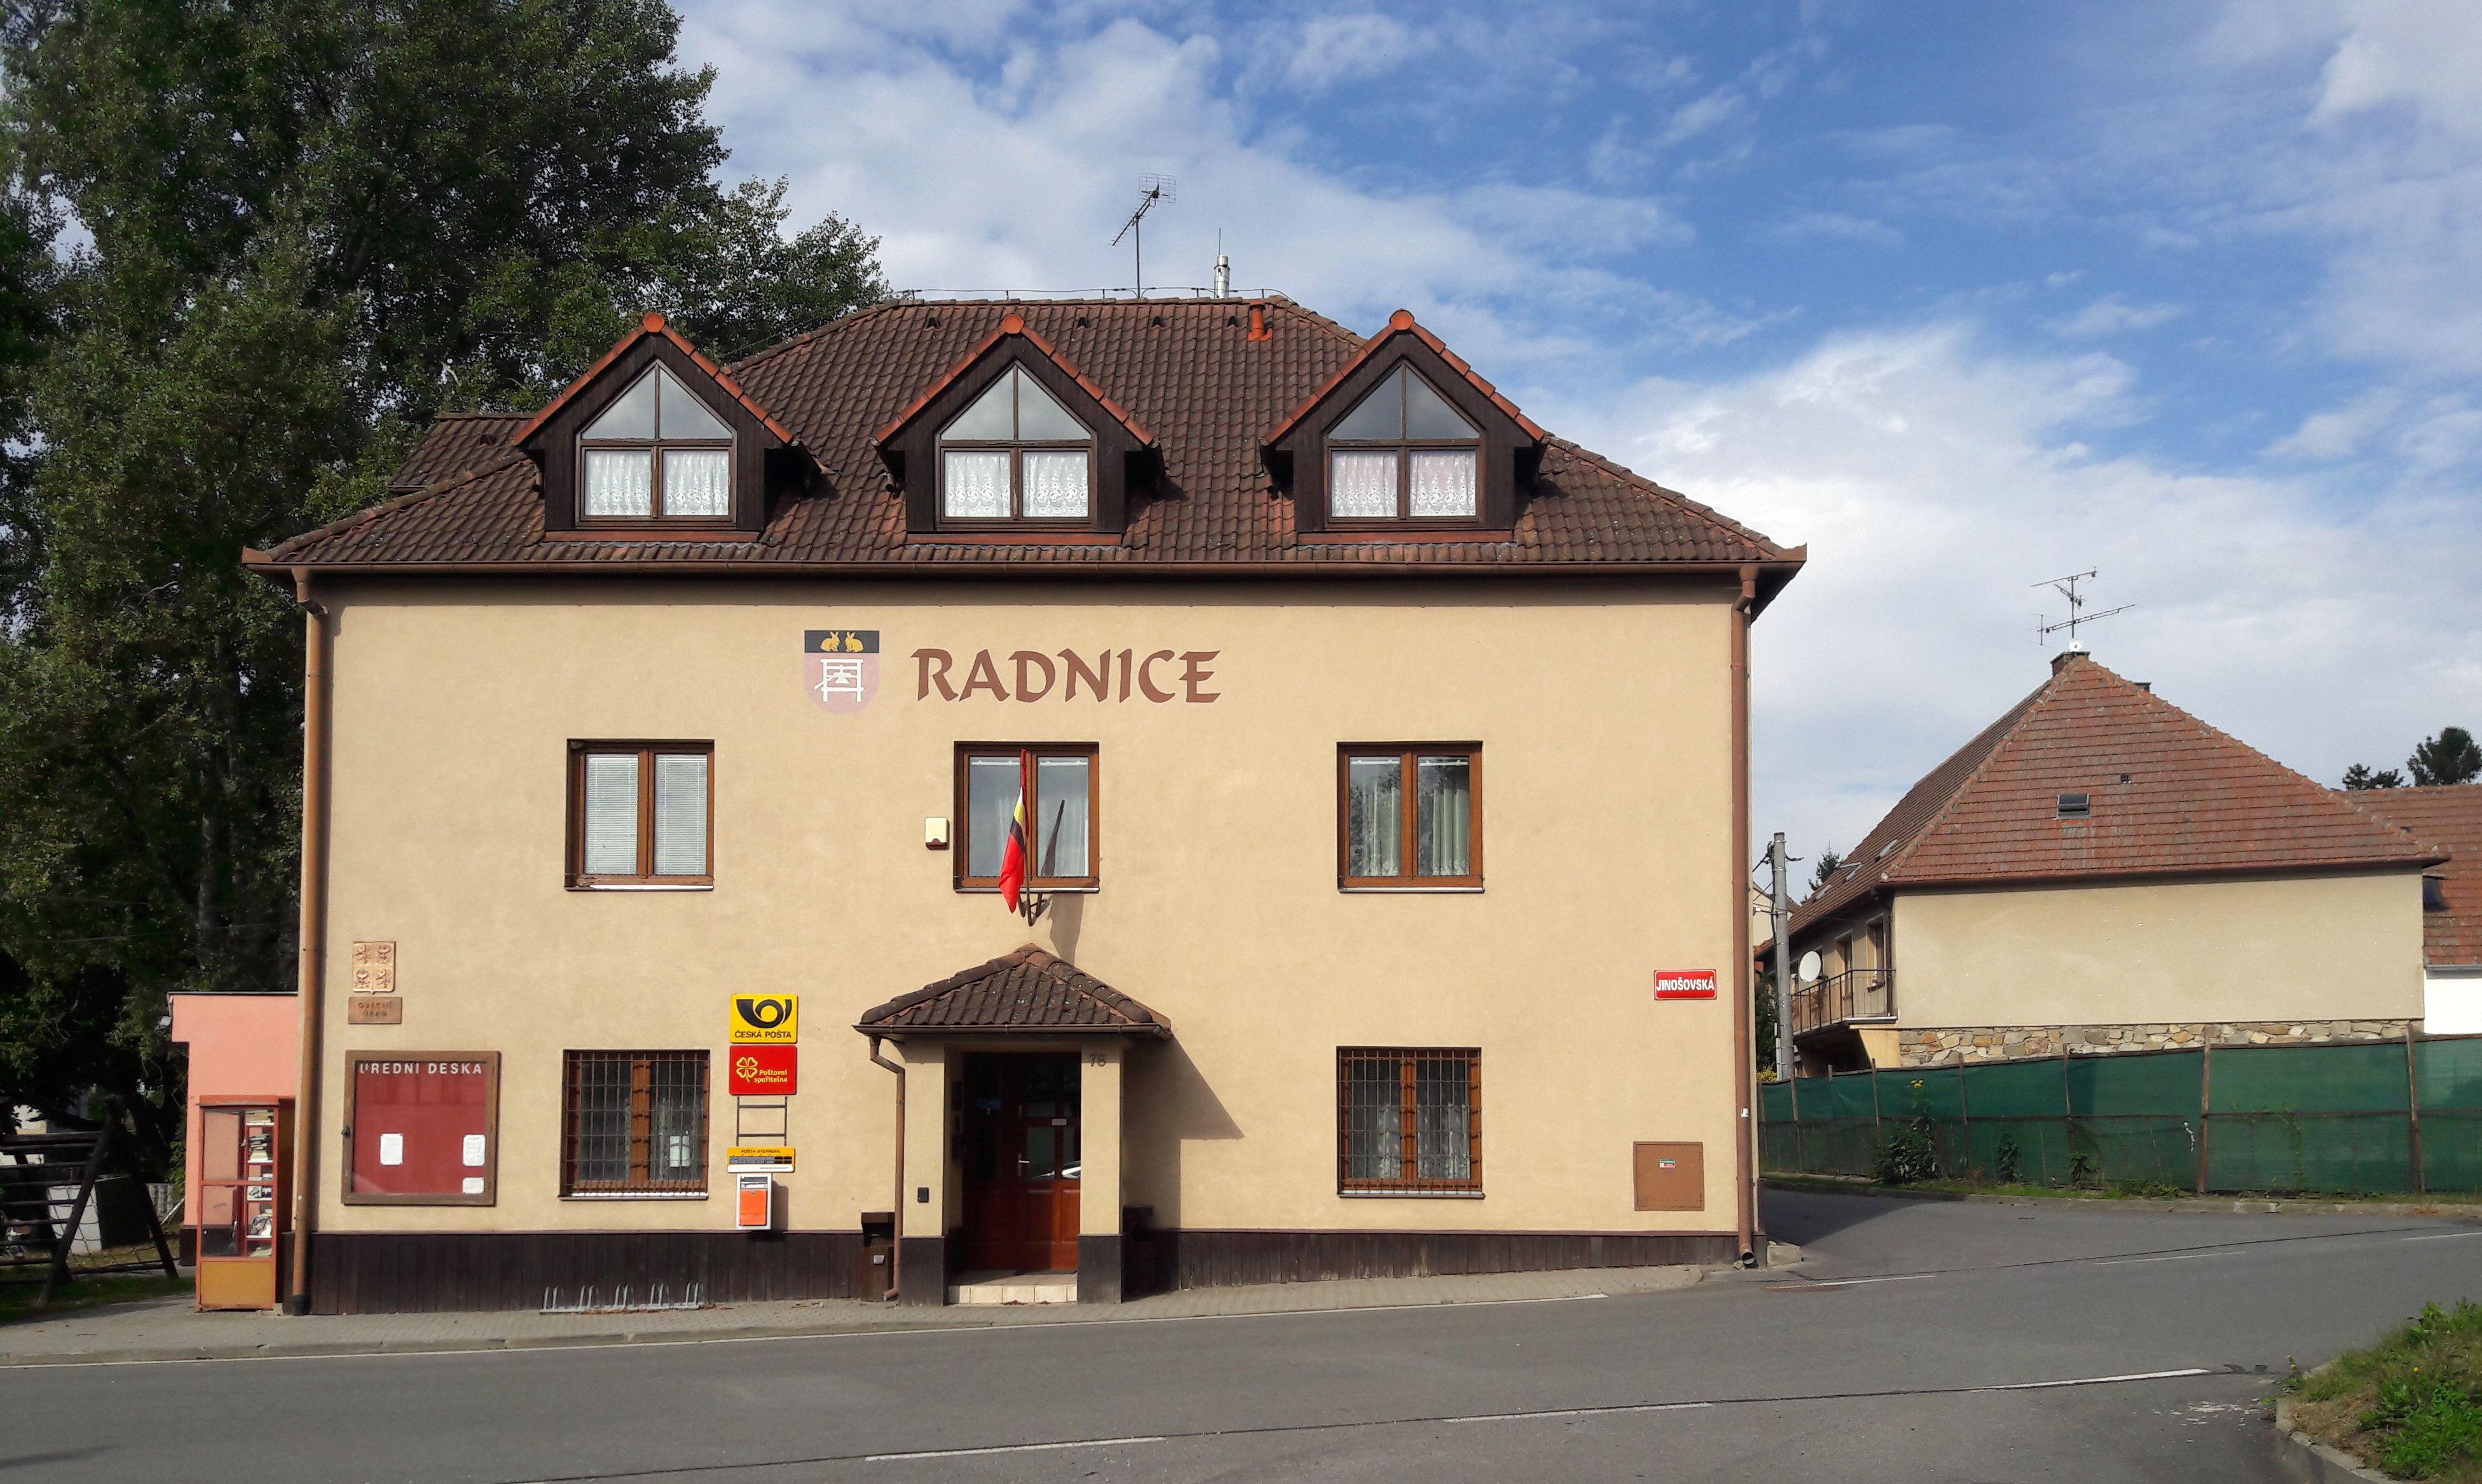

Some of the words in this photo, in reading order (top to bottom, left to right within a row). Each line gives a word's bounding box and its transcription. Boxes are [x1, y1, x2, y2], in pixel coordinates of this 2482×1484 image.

[910, 648, 1221, 703] RADNICE
[1656, 976, 1715, 991] JINOŠOVSKÁ
[734, 1029, 762, 1038] ČESKÁ
[765, 1029, 792, 1038] POŠTA
[427, 1063, 482, 1074] DESKA
[754, 1075, 788, 1084] spořitelna
